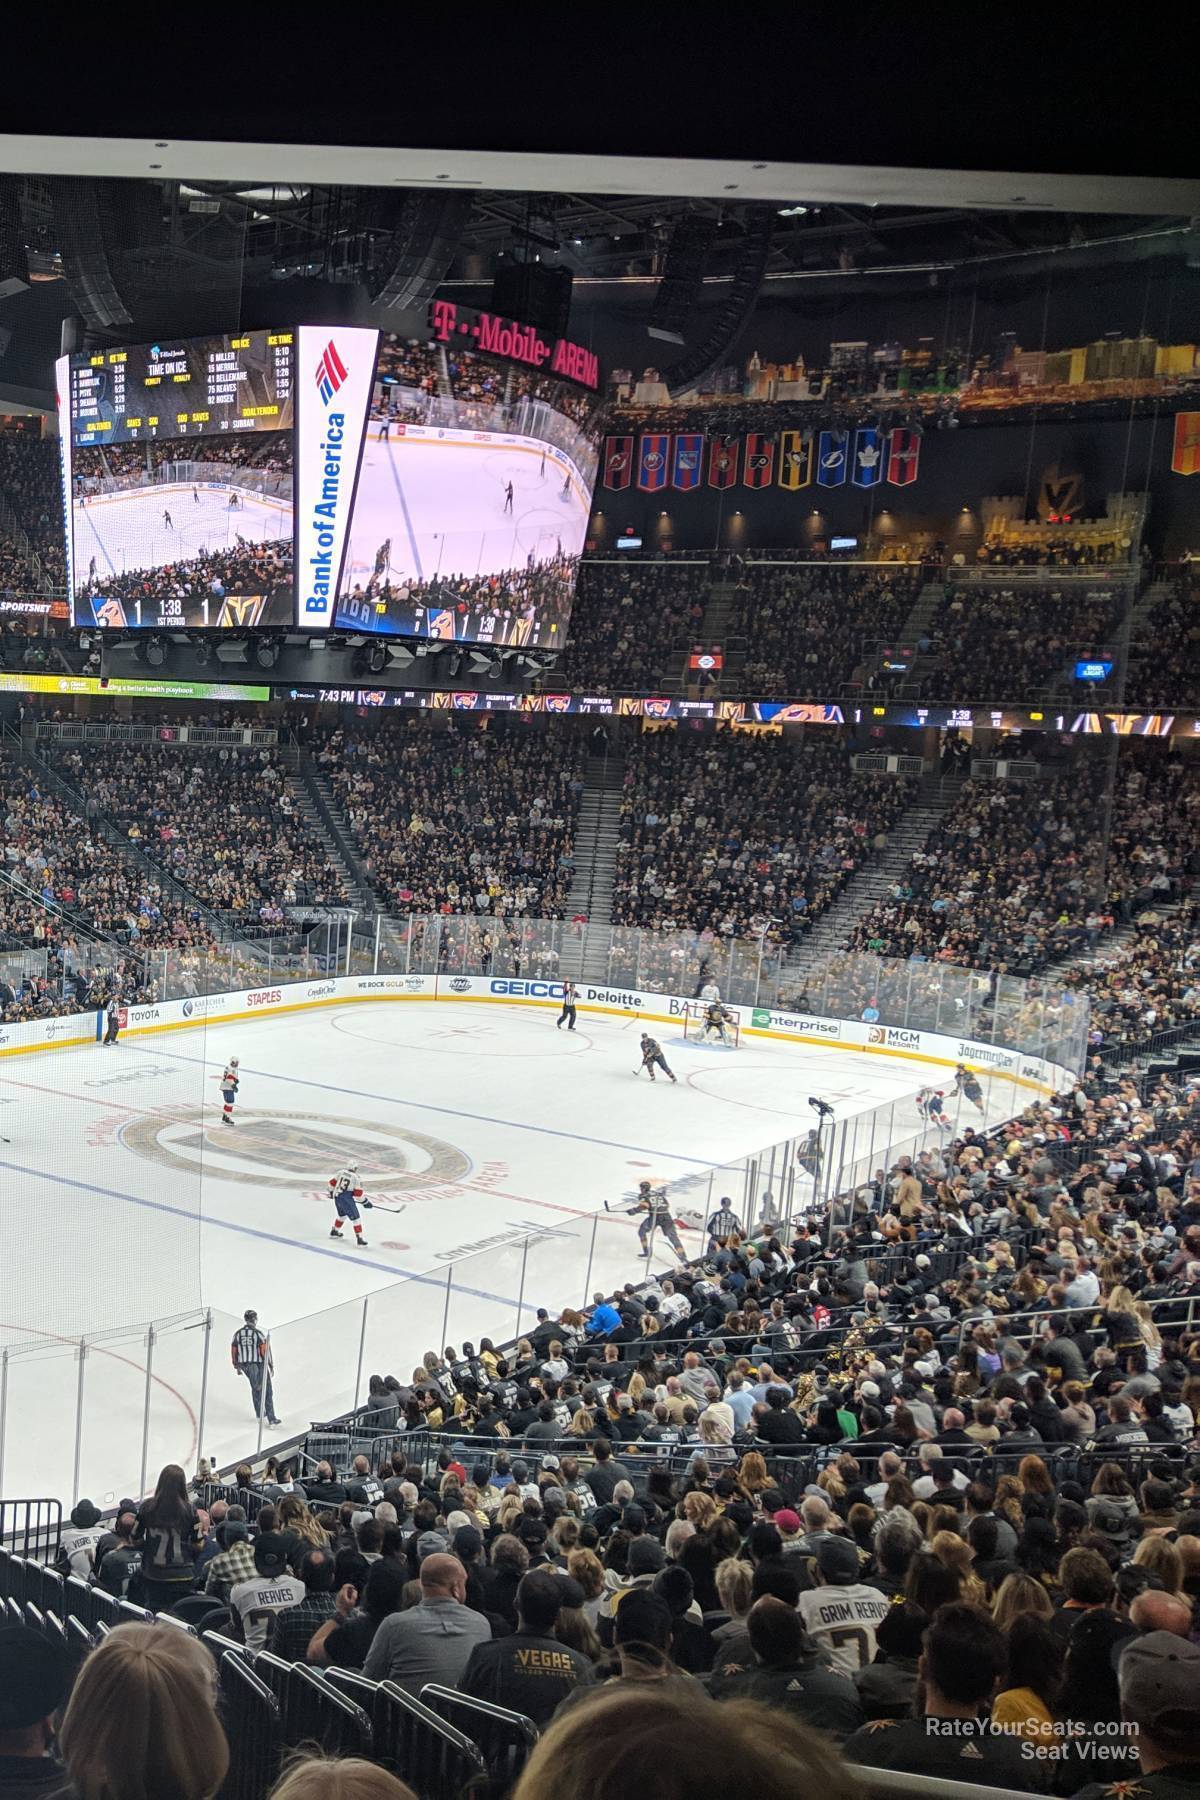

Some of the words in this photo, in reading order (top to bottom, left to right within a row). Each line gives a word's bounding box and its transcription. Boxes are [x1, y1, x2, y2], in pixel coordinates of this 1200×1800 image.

[268, 336, 278, 345] ICE
[278, 335, 293, 344] TIME
[148, 364, 164, 376] TIME
[165, 363, 175, 374] ON
[176, 361, 187, 373] ICE
[552, 339, 599, 390] ARENA
[173, 374, 191, 382] PENALTY
[192, 412, 209, 422] SAVES
[242, 406, 278, 417] GOALTENDER
[199, 424, 203, 432] 7
[315, 413, 345, 519] America
[313, 521, 334, 548] of
[306, 556, 332, 612] Bank
[0, 601, 51, 613] SPORTSNET
[134, 600, 141, 625] 1
[160, 600, 181, 615] 1:38
[201, 599, 209, 625] 1
[462, 615, 469, 637] 1
[479, 616, 496, 633] 1:38
[502, 619, 509, 644] 1
[319, 689, 339, 702] 7:43
[341, 691, 354, 702] PM
[580, 705, 590, 713] 1/1
[682, 709, 688, 717] 2
[855, 710, 861, 723] 1
[952, 710, 970, 720] 1:38
[1056, 716, 1063, 730] 1
[490, 980, 565, 999] GEICO
[246, 990, 282, 1007] STAPLES
[130, 1009, 160, 1022] TOYOTA
[756, 1012, 839, 1034] enterprise
[887, 1029, 921, 1044] MGM
[887, 1041, 920, 1050] RESORTS
[338, 1176, 351, 1193] 13
[470, 1161, 511, 1192] ARENA
[458, 1229, 530, 1253] NATIONAL
[73, 1536, 92, 1548] VEGAS
[150, 1528, 185, 1567] 71
[257, 1588, 294, 1605] REAVES
[819, 1603, 854, 1624] GRIM
[517, 1648, 571, 1671] VEGAS
